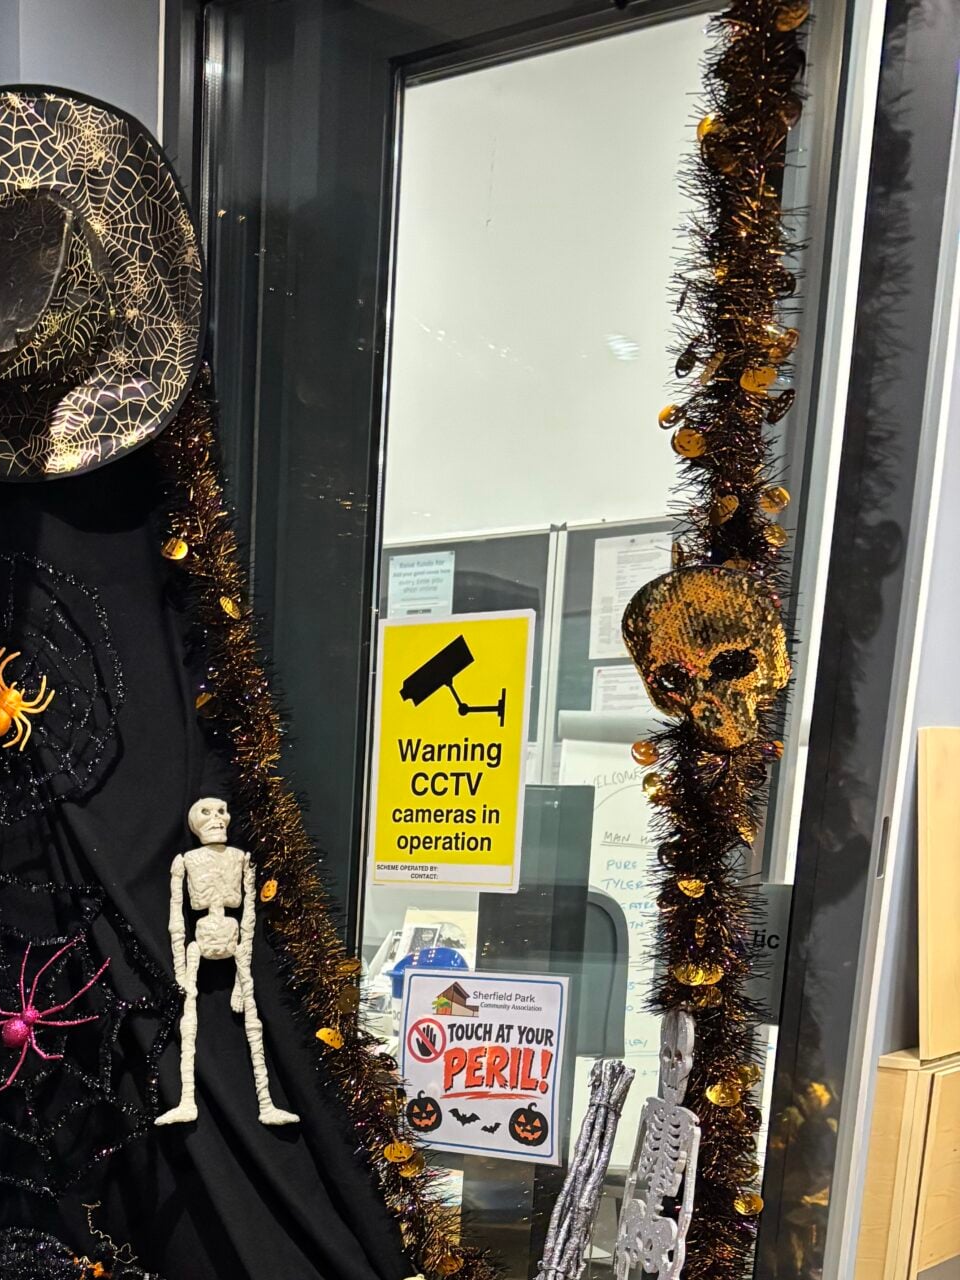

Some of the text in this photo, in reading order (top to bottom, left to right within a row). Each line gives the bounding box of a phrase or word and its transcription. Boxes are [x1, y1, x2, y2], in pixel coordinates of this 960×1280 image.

[397, 737, 502, 768] Warning
[411, 772, 483, 796] CCTV
[392, 804, 500, 824] cameras in
[397, 832, 492, 855] operation
[472, 990, 536, 1003] Sherfield Park
[480, 1001, 543, 1012] Community Association
[448, 1023, 554, 1047] TOUCH AT YOUR
[443, 1046, 554, 1094] PERIL!
